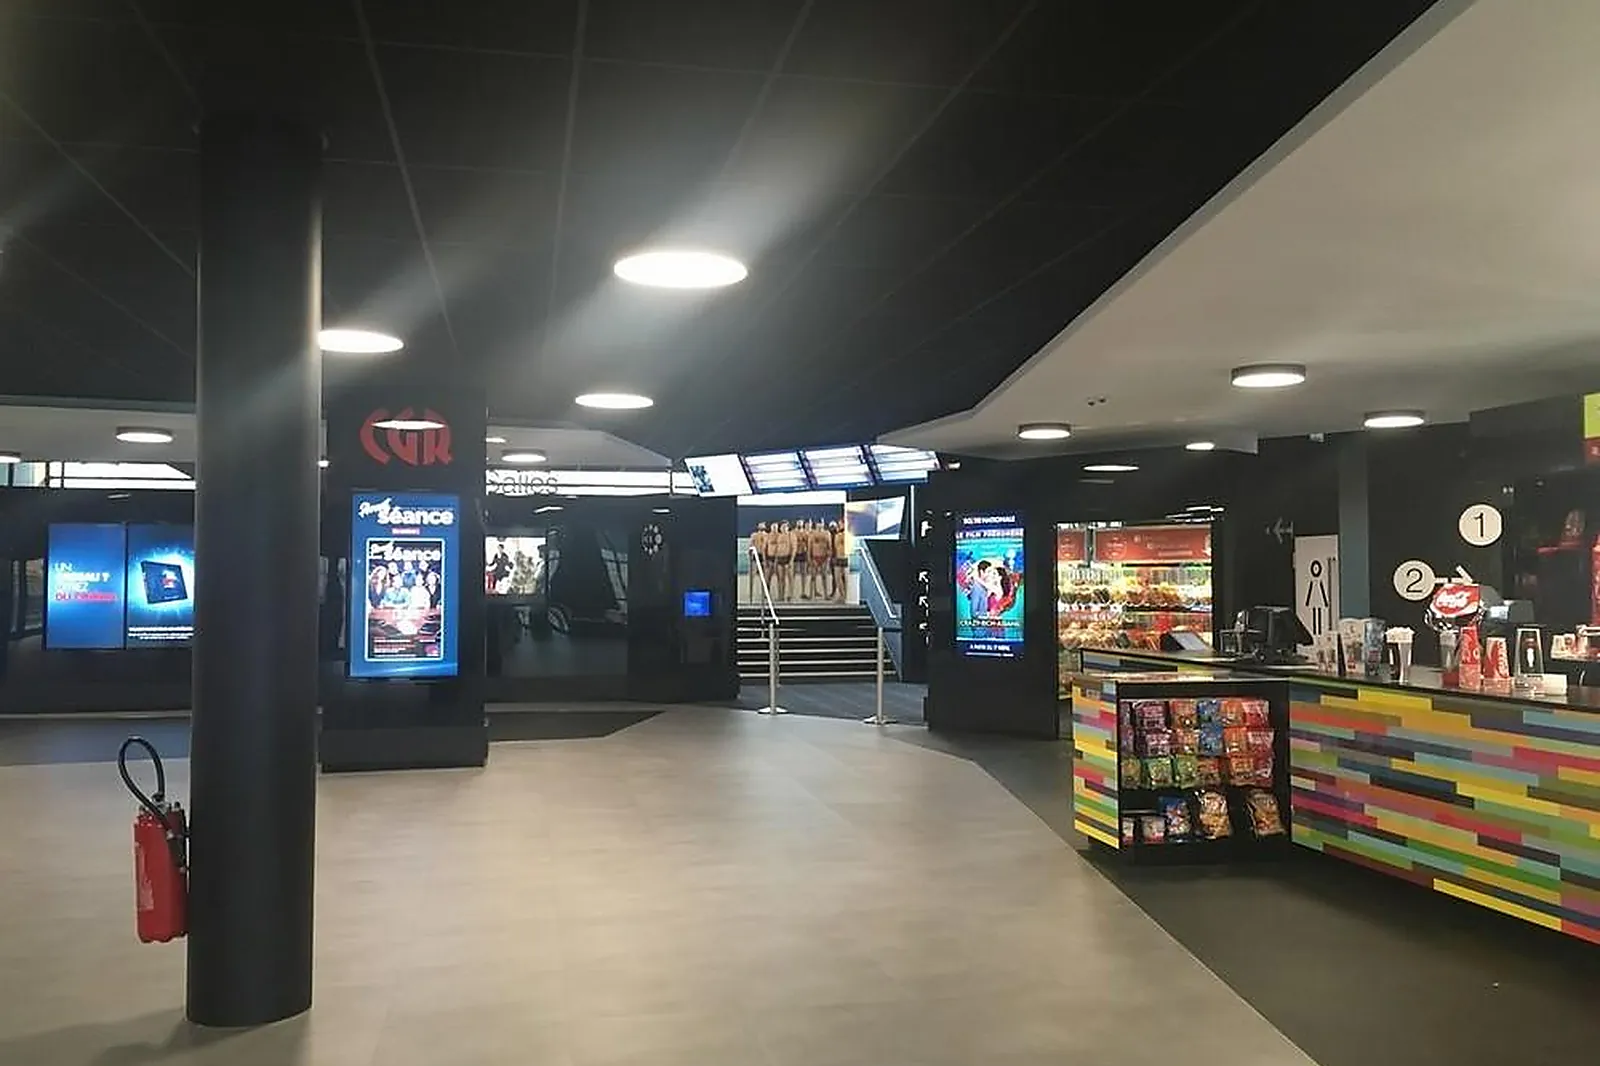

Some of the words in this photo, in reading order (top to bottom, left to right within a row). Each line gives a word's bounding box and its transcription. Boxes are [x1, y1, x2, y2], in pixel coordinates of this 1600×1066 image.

[359, 408, 453, 466] CGR
[484, 470, 558, 494] Salles
[377, 506, 455, 525] séance
[1474, 512, 1484, 538] 1
[1405, 567, 1423, 593] 2
